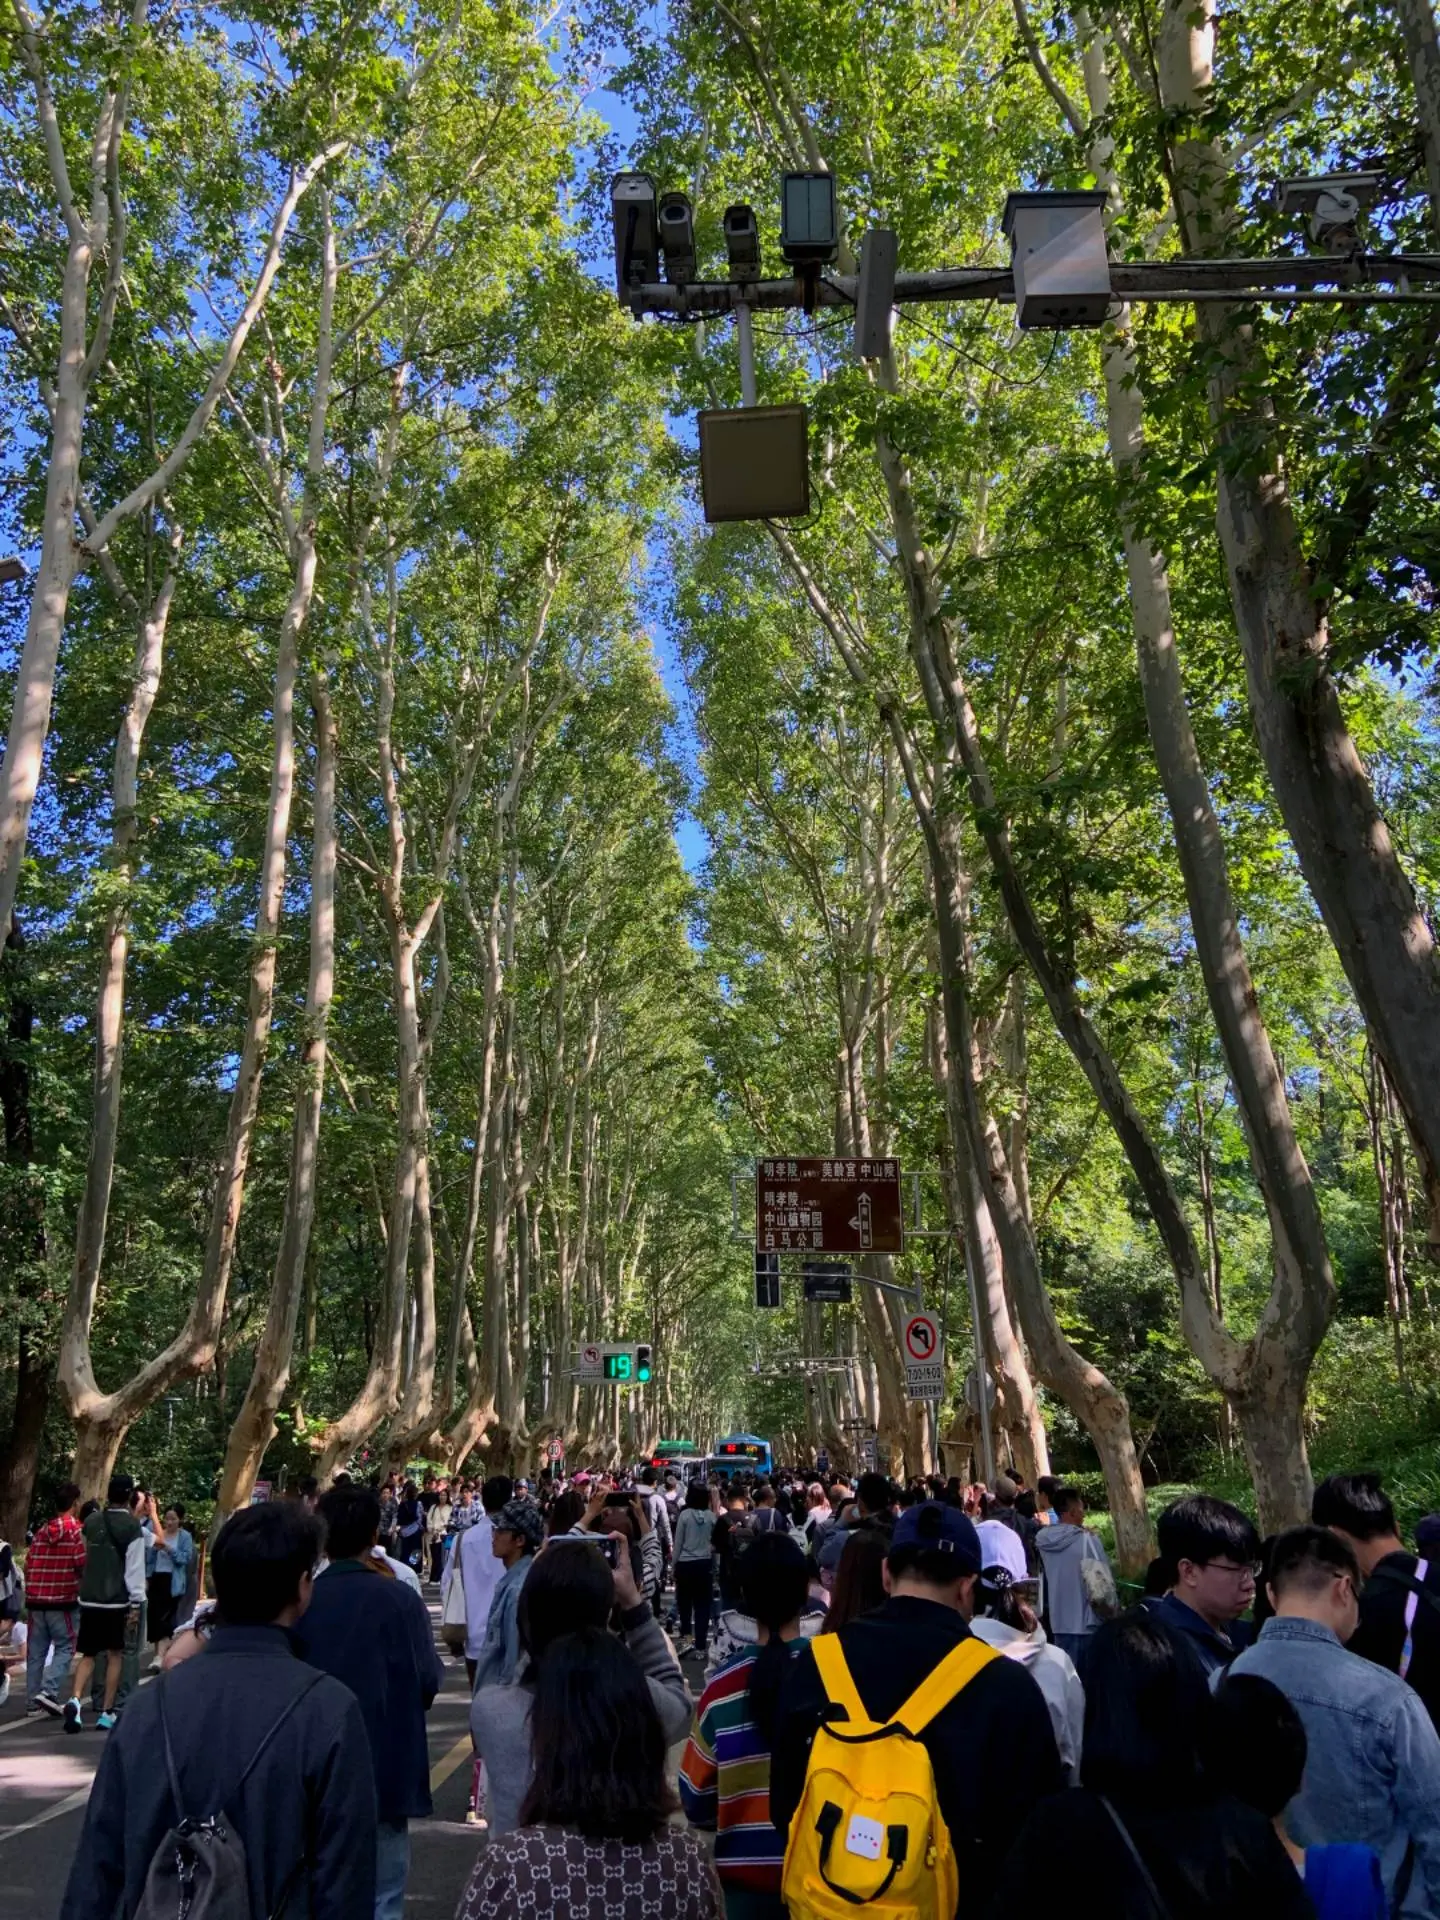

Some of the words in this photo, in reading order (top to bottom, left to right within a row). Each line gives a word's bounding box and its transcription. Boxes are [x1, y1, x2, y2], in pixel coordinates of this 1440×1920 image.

[764, 1162, 798, 1177] 明孝陵
[860, 1162, 896, 1177] 中山陵
[764, 1191, 799, 1207] 明孝陵
[764, 1211, 823, 1227] 中山植物园
[765, 1231, 823, 1247] 白马公园
[610, 1355, 631, 1379] 19
